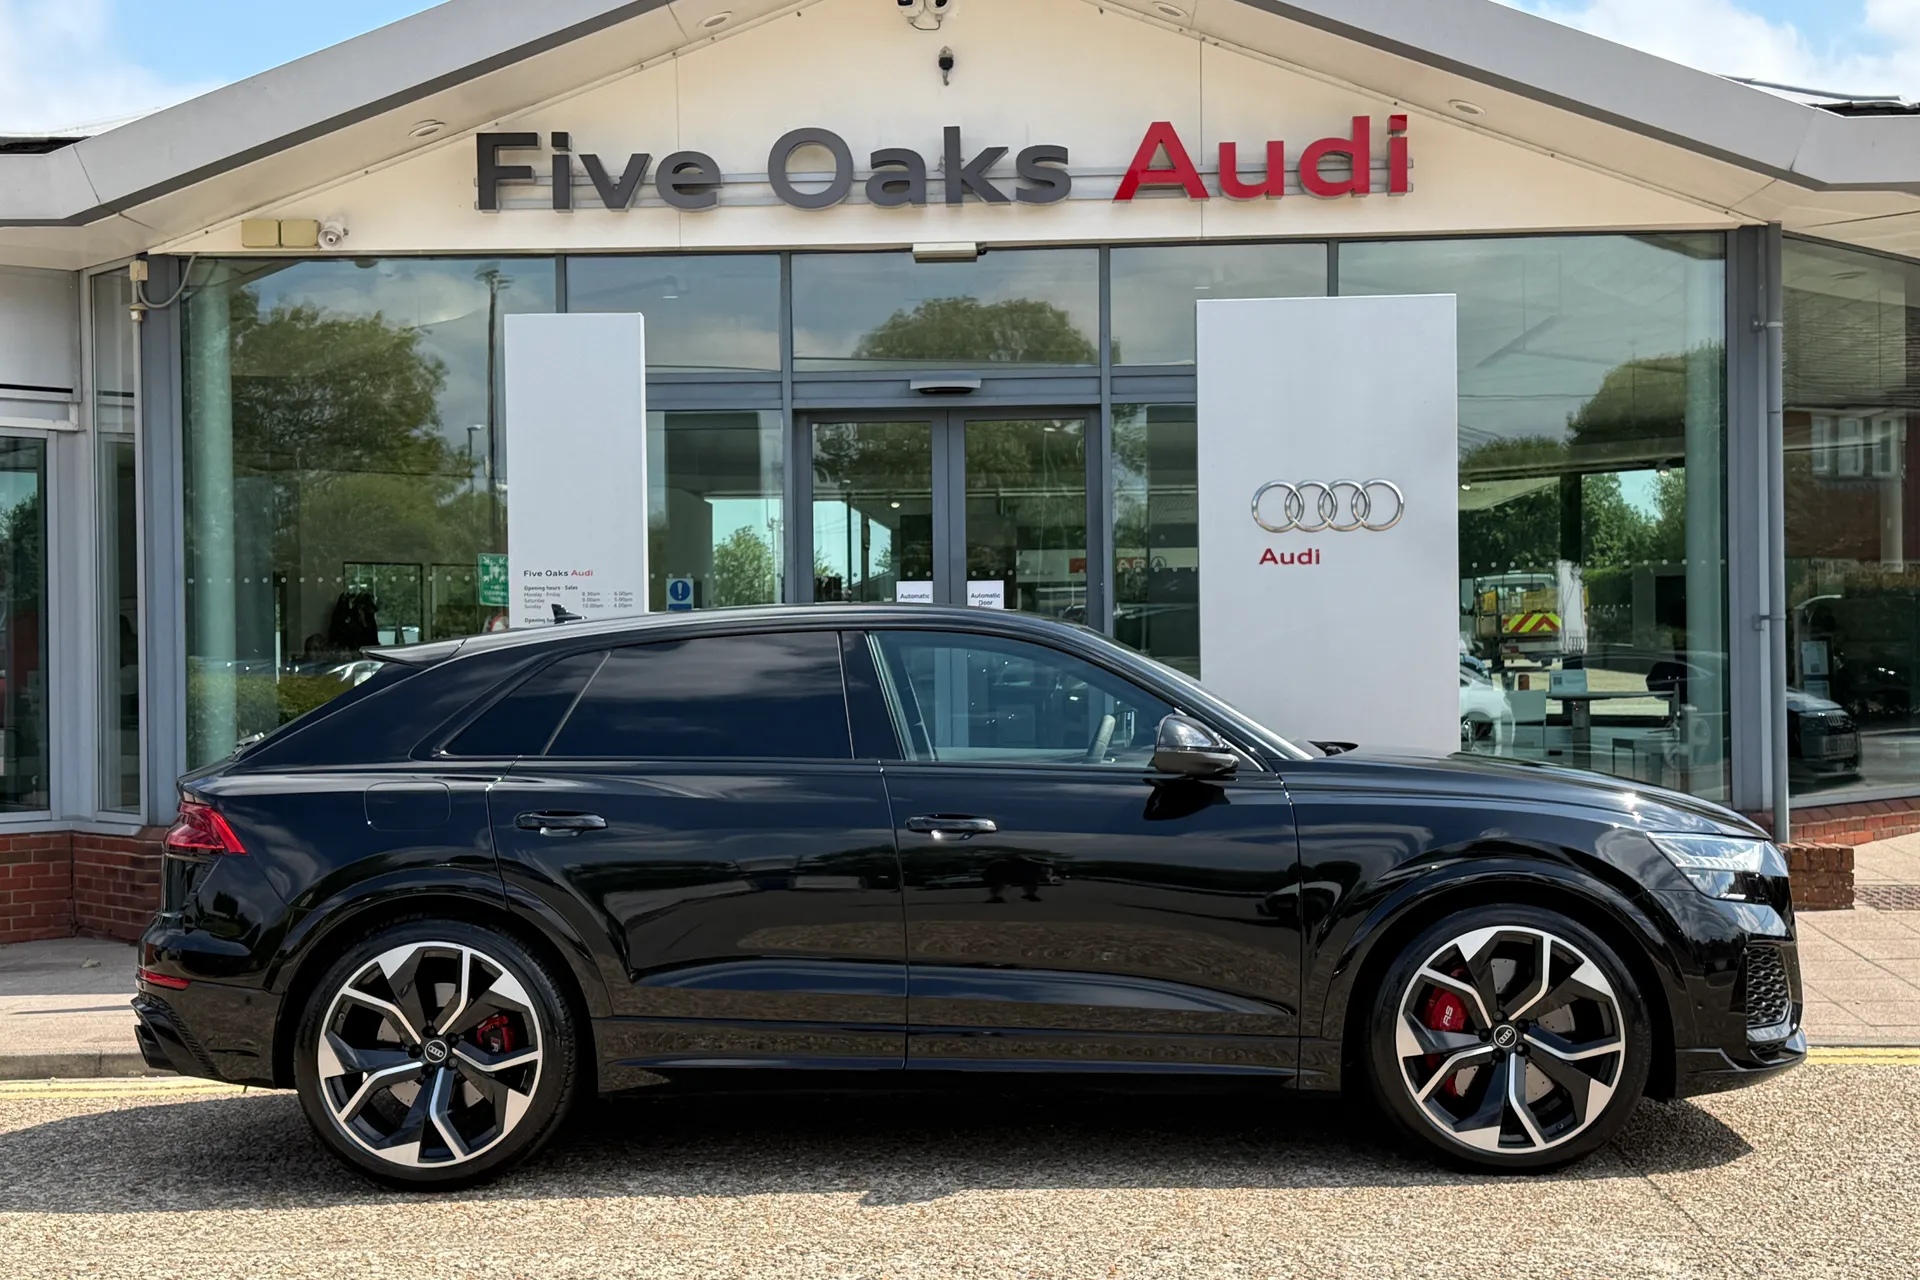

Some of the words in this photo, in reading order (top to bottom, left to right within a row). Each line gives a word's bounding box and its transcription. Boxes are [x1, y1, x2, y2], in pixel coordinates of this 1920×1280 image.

[476, 131, 723, 213] Five
[767, 126, 1073, 211] Oaks
[1112, 114, 1408, 204] Audi
[1258, 547, 1321, 565] Audi
[545, 569, 569, 577] Oaks
[571, 569, 594, 577] Audi
[1443, 1005, 1453, 1026] RS
